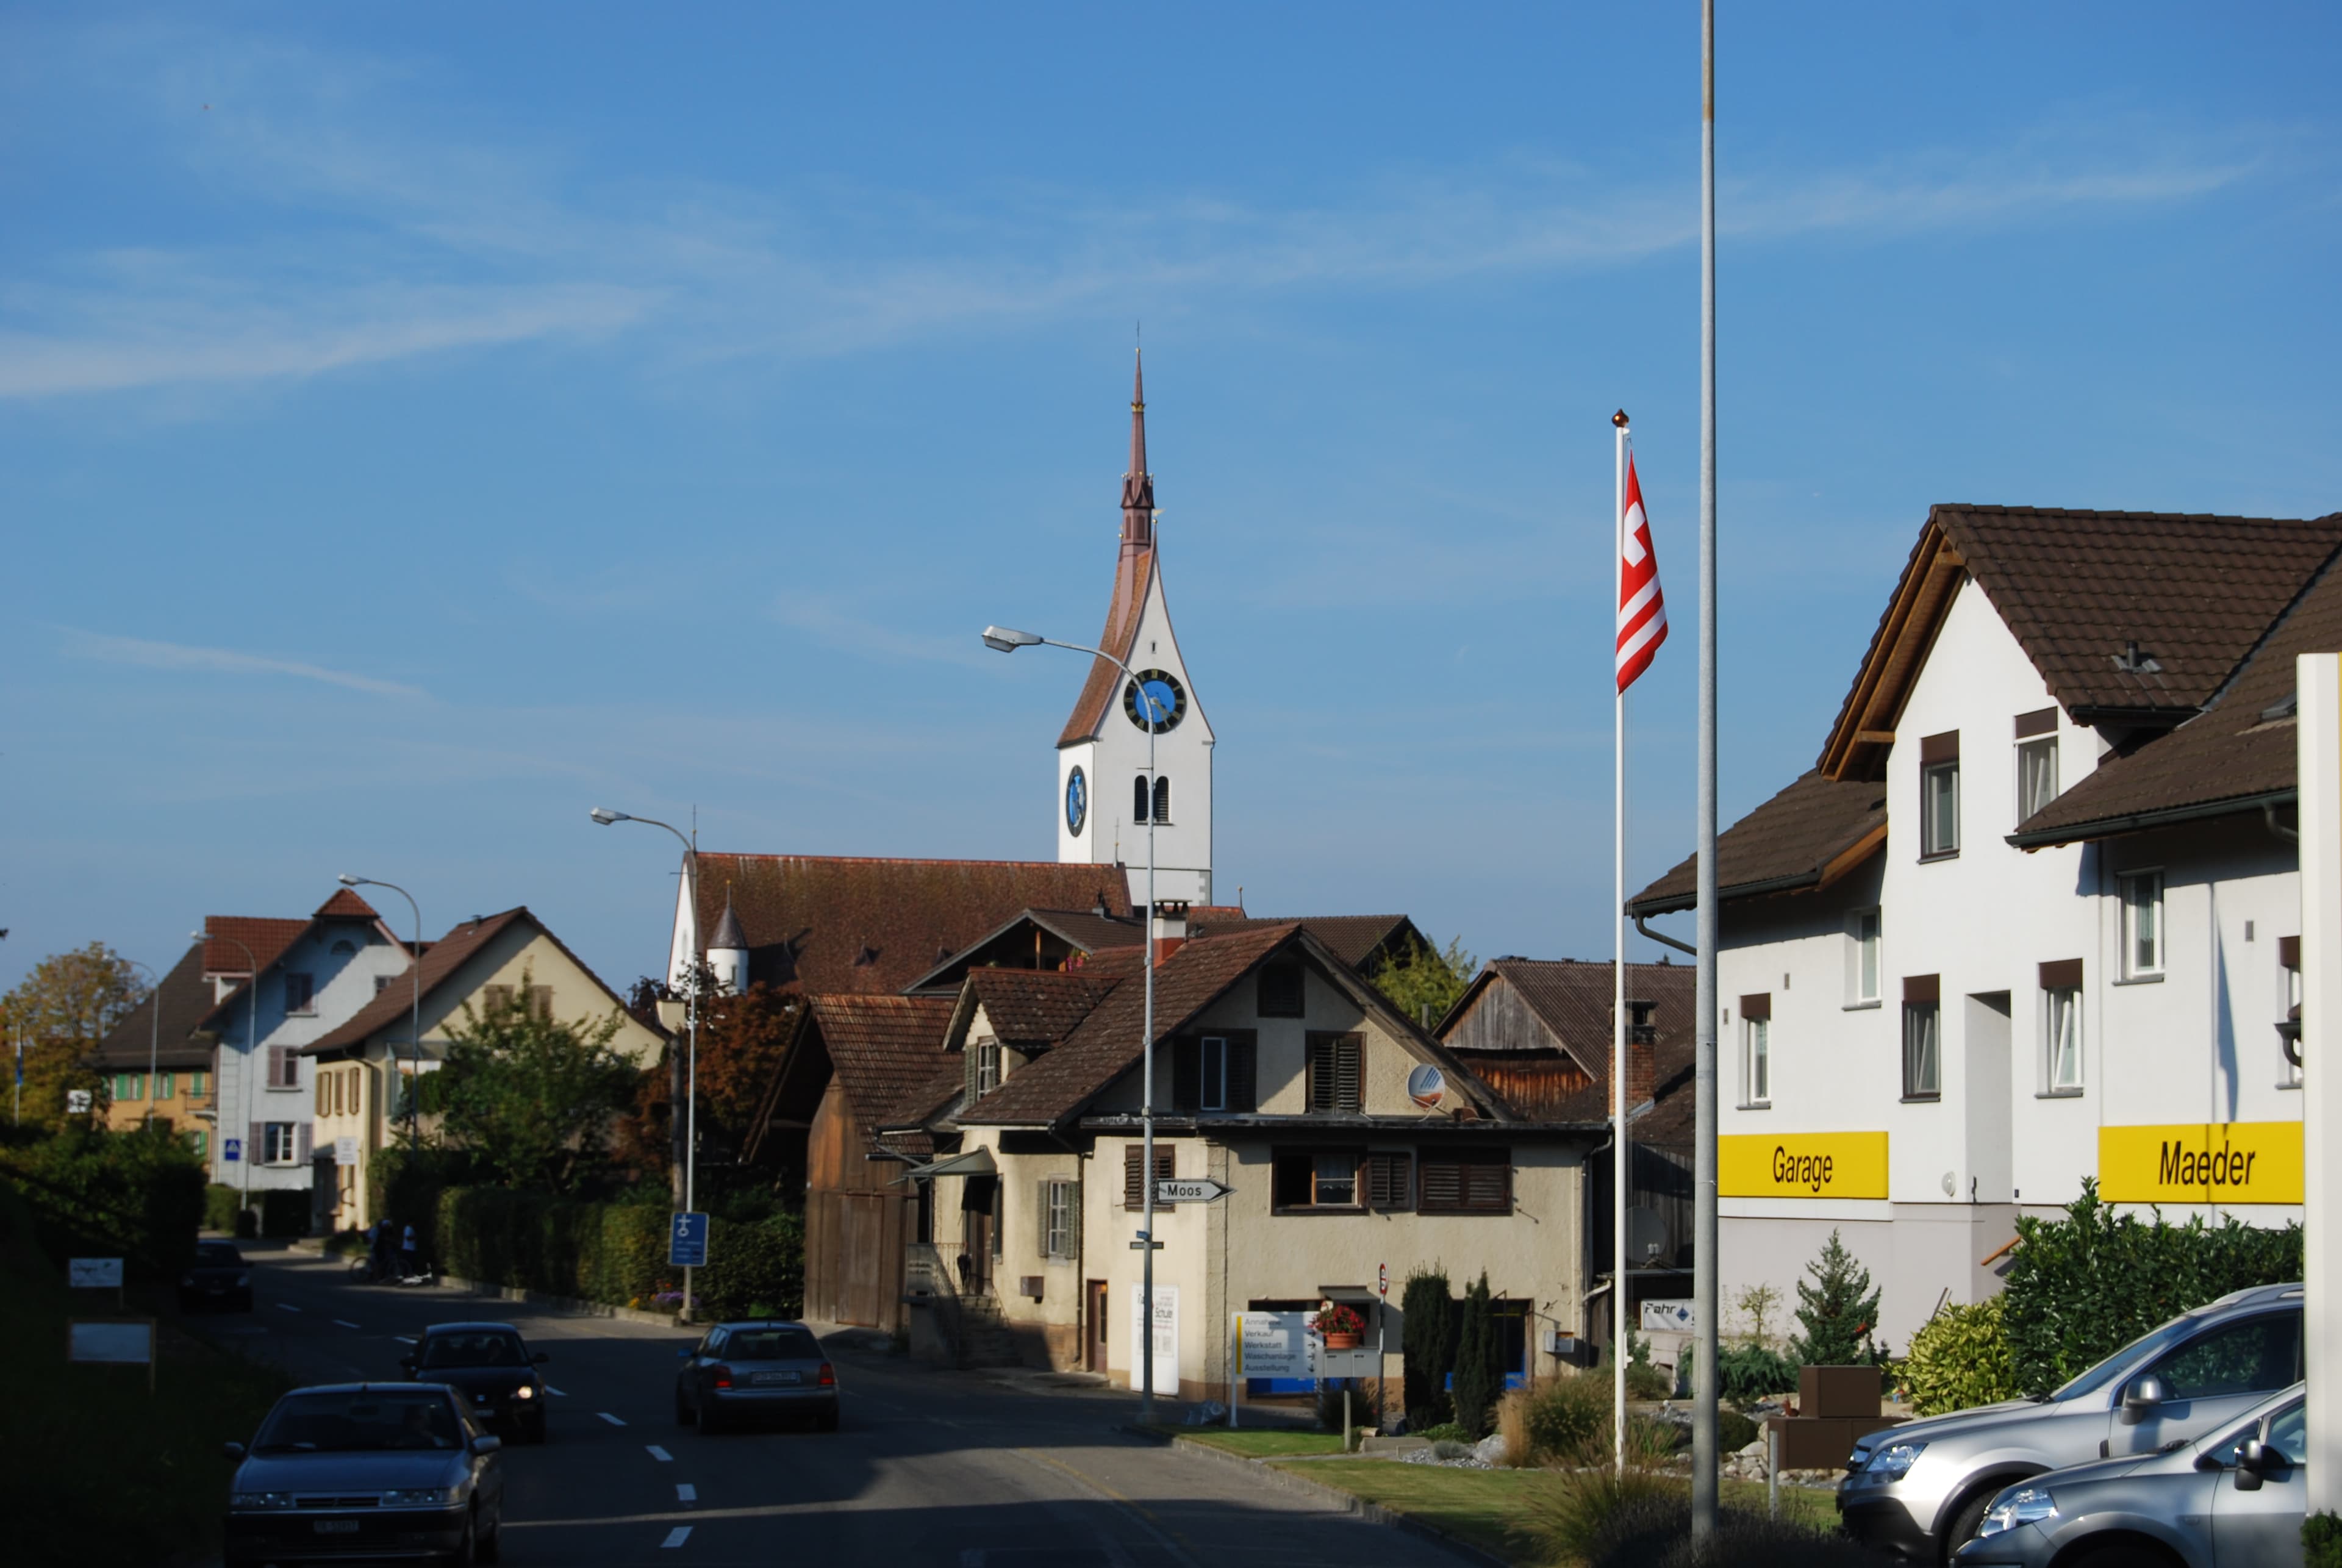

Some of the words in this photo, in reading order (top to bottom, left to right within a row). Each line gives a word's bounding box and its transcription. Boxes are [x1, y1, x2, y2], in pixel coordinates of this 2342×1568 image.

[2159, 1140, 2256, 1186] Maeder
[1773, 1145, 1833, 1193] Garage
[1167, 1184, 1202, 1196] Moos
[1645, 1303, 1676, 1314] Fahr
[1245, 1352, 1296, 1361] Waschanlage
[1245, 1364, 1290, 1372] Ausstellung
